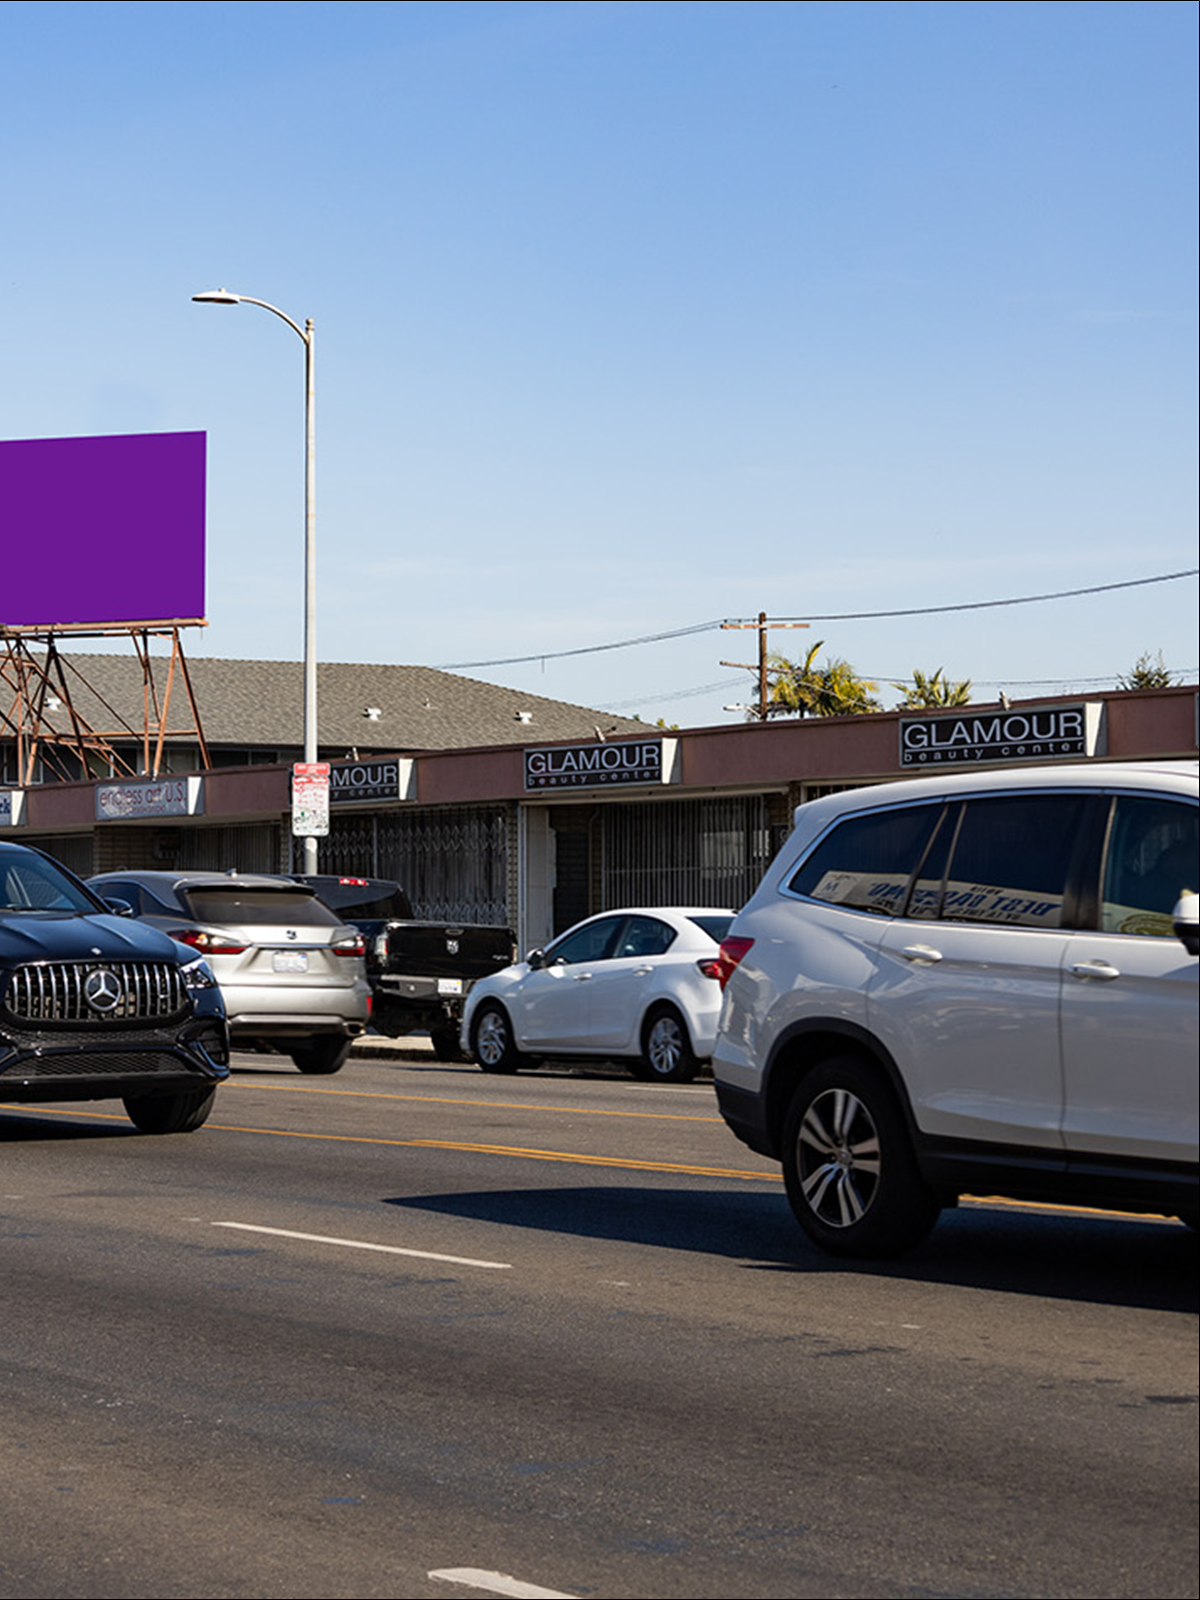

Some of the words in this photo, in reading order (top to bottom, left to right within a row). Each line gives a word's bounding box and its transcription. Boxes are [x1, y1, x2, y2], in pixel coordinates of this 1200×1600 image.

[904, 712, 1083, 748] GLAMOUR
[528, 745, 660, 774] GLAMOUR
[904, 748, 983, 762] beauty
[1001, 742, 1084, 756] center
[330, 765, 398, 787] MOUR
[528, 774, 588, 786] beauty
[600, 770, 660, 782] center
[349, 785, 398, 797] center
